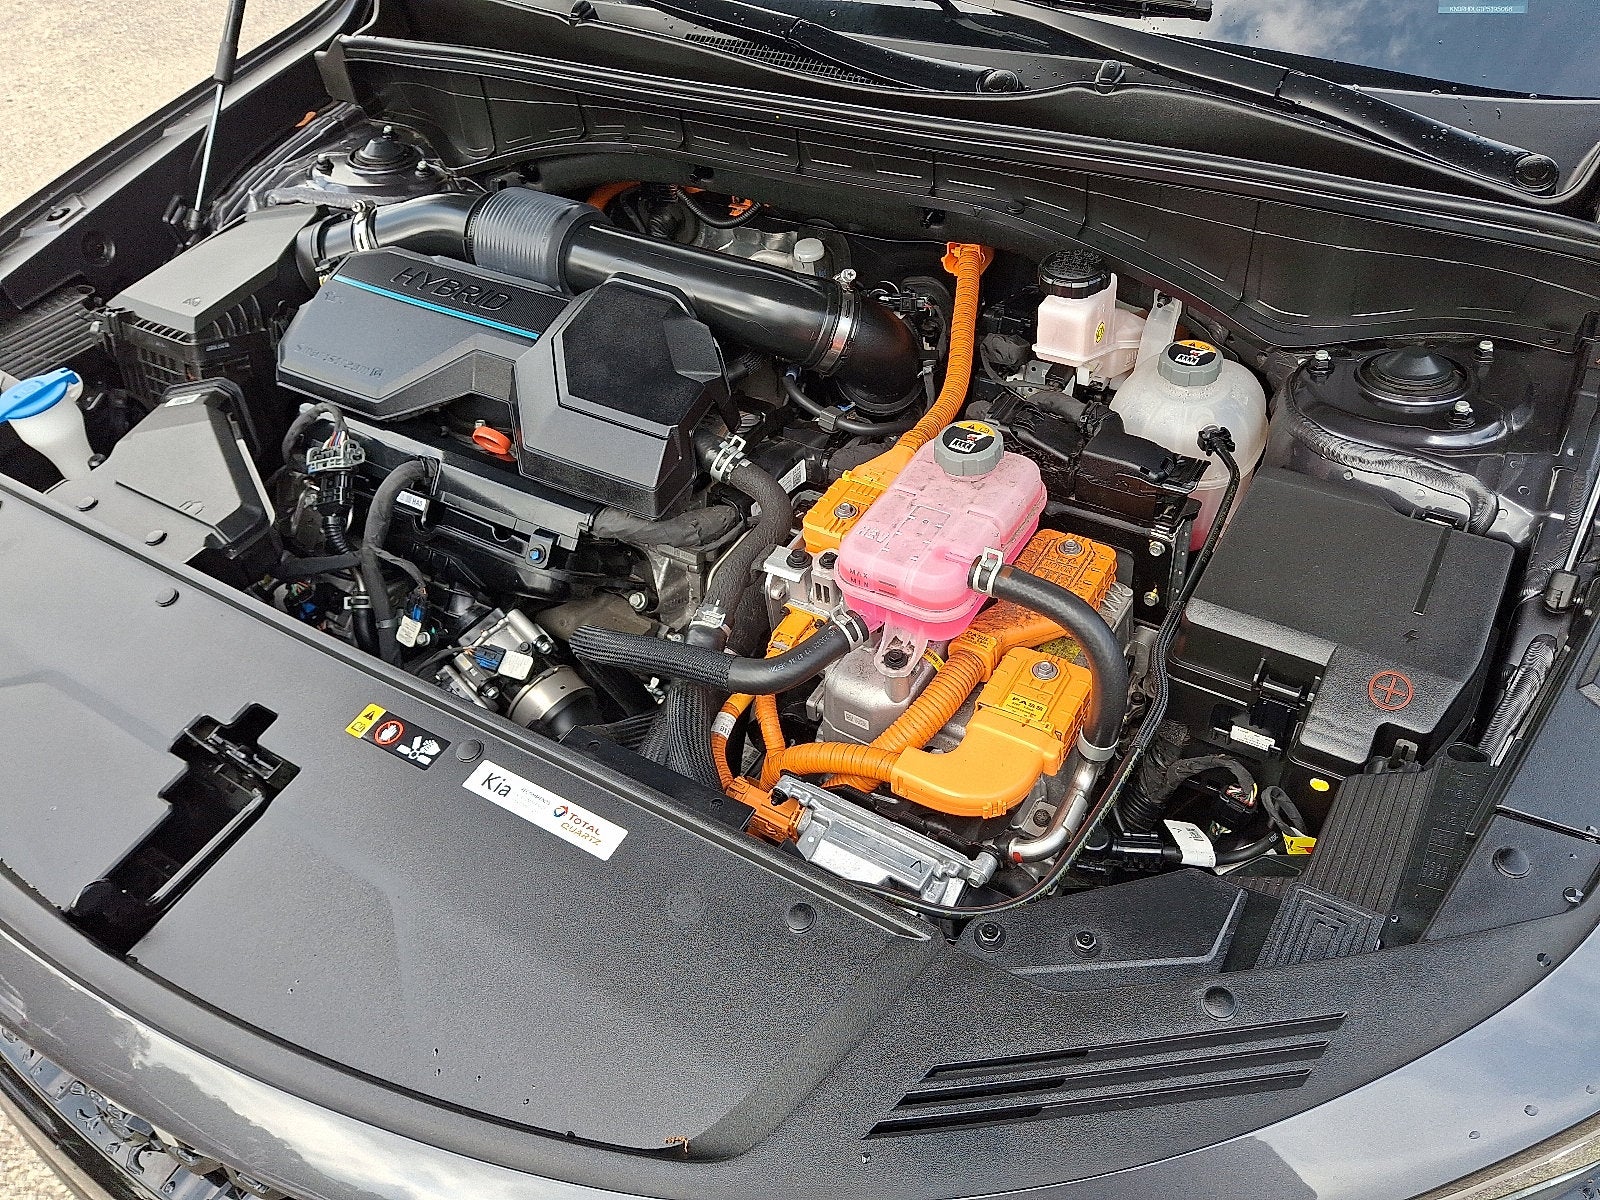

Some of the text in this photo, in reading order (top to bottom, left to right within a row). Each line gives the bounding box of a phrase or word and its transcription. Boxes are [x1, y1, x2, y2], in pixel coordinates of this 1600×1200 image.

[390, 266, 512, 311] HYBRID
[849, 567, 868, 579] MAX
[850, 576, 869, 588] MIN
[1012, 696, 1044, 712] PASS
[481, 772, 512, 798] Kia
[560, 822, 602, 846] QUARTZ
[568, 812, 601, 836] TOTAL
